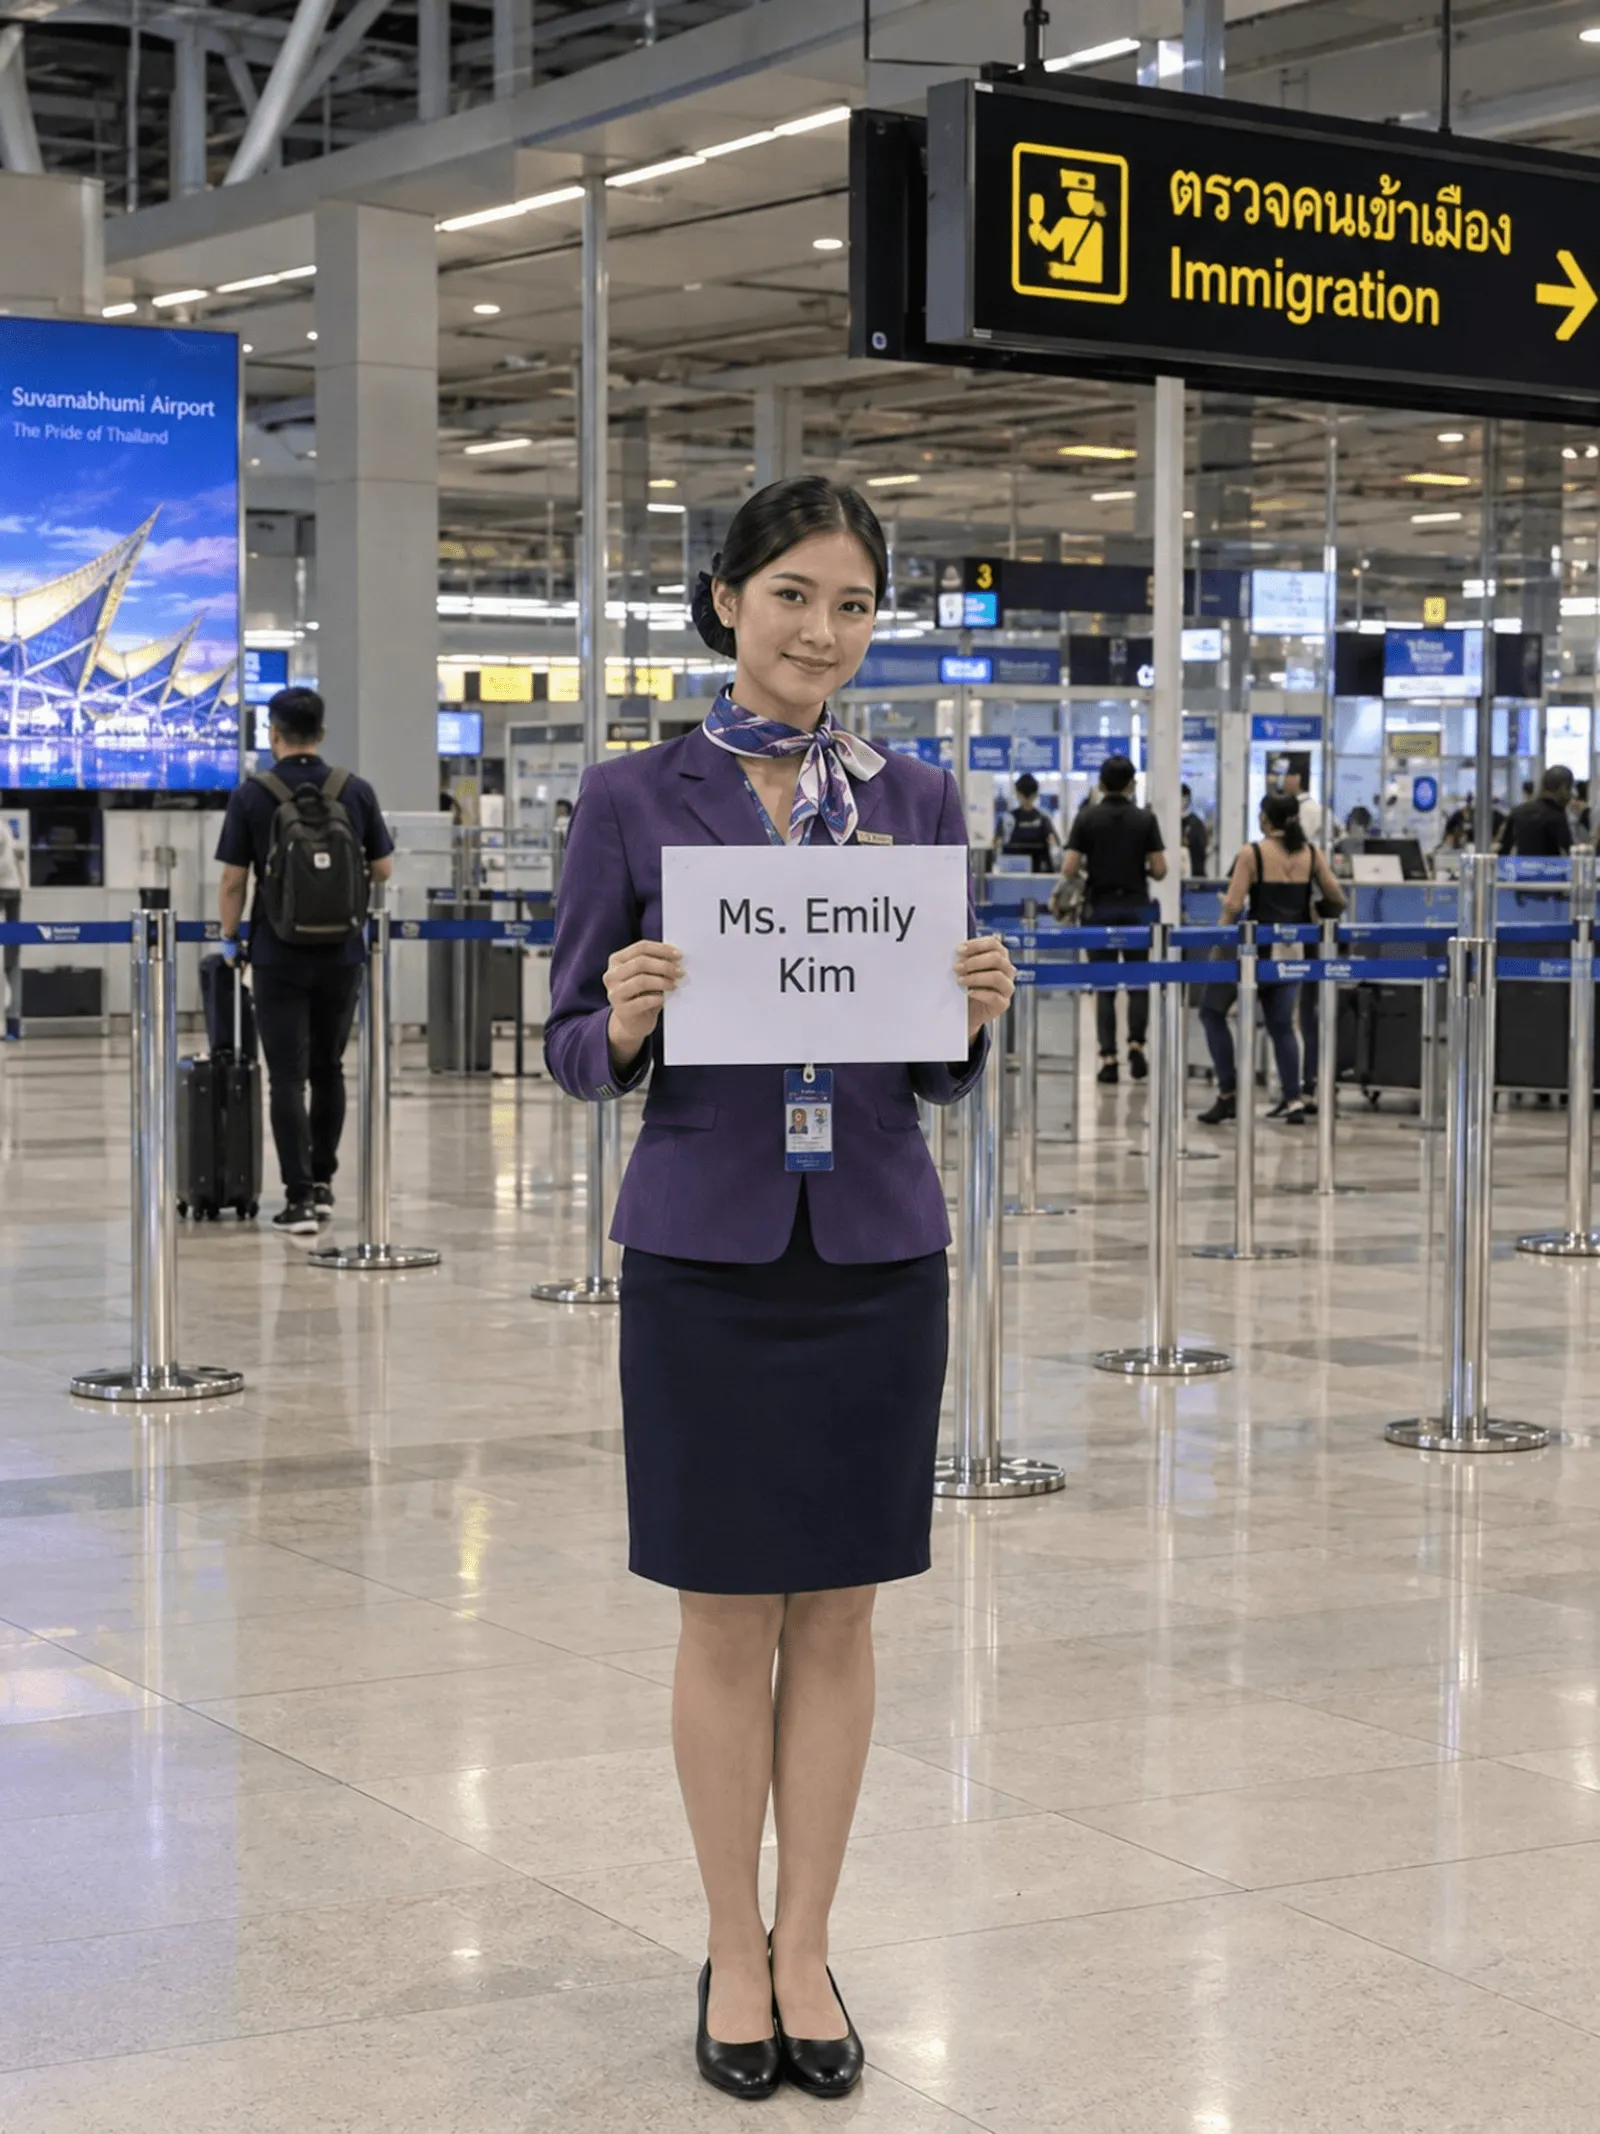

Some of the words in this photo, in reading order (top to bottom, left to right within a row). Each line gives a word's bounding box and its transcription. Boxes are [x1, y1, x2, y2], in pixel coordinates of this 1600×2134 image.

[1170, 169, 1512, 256] ตรวจคนเข้าเมือง
[1171, 246, 1440, 326] Immigration
[12, 386, 146, 413] Suvarnabhumi
[150, 395, 216, 420] Airport
[13, 421, 41, 438] The
[44, 424, 84, 441] Pride
[86, 426, 104, 441] of
[107, 426, 169, 445] Thailand
[976, 562, 994, 590] 3
[718, 897, 788, 936] Ms.
[806, 895, 917, 943] Emily
[779, 956, 856, 994] Kim
